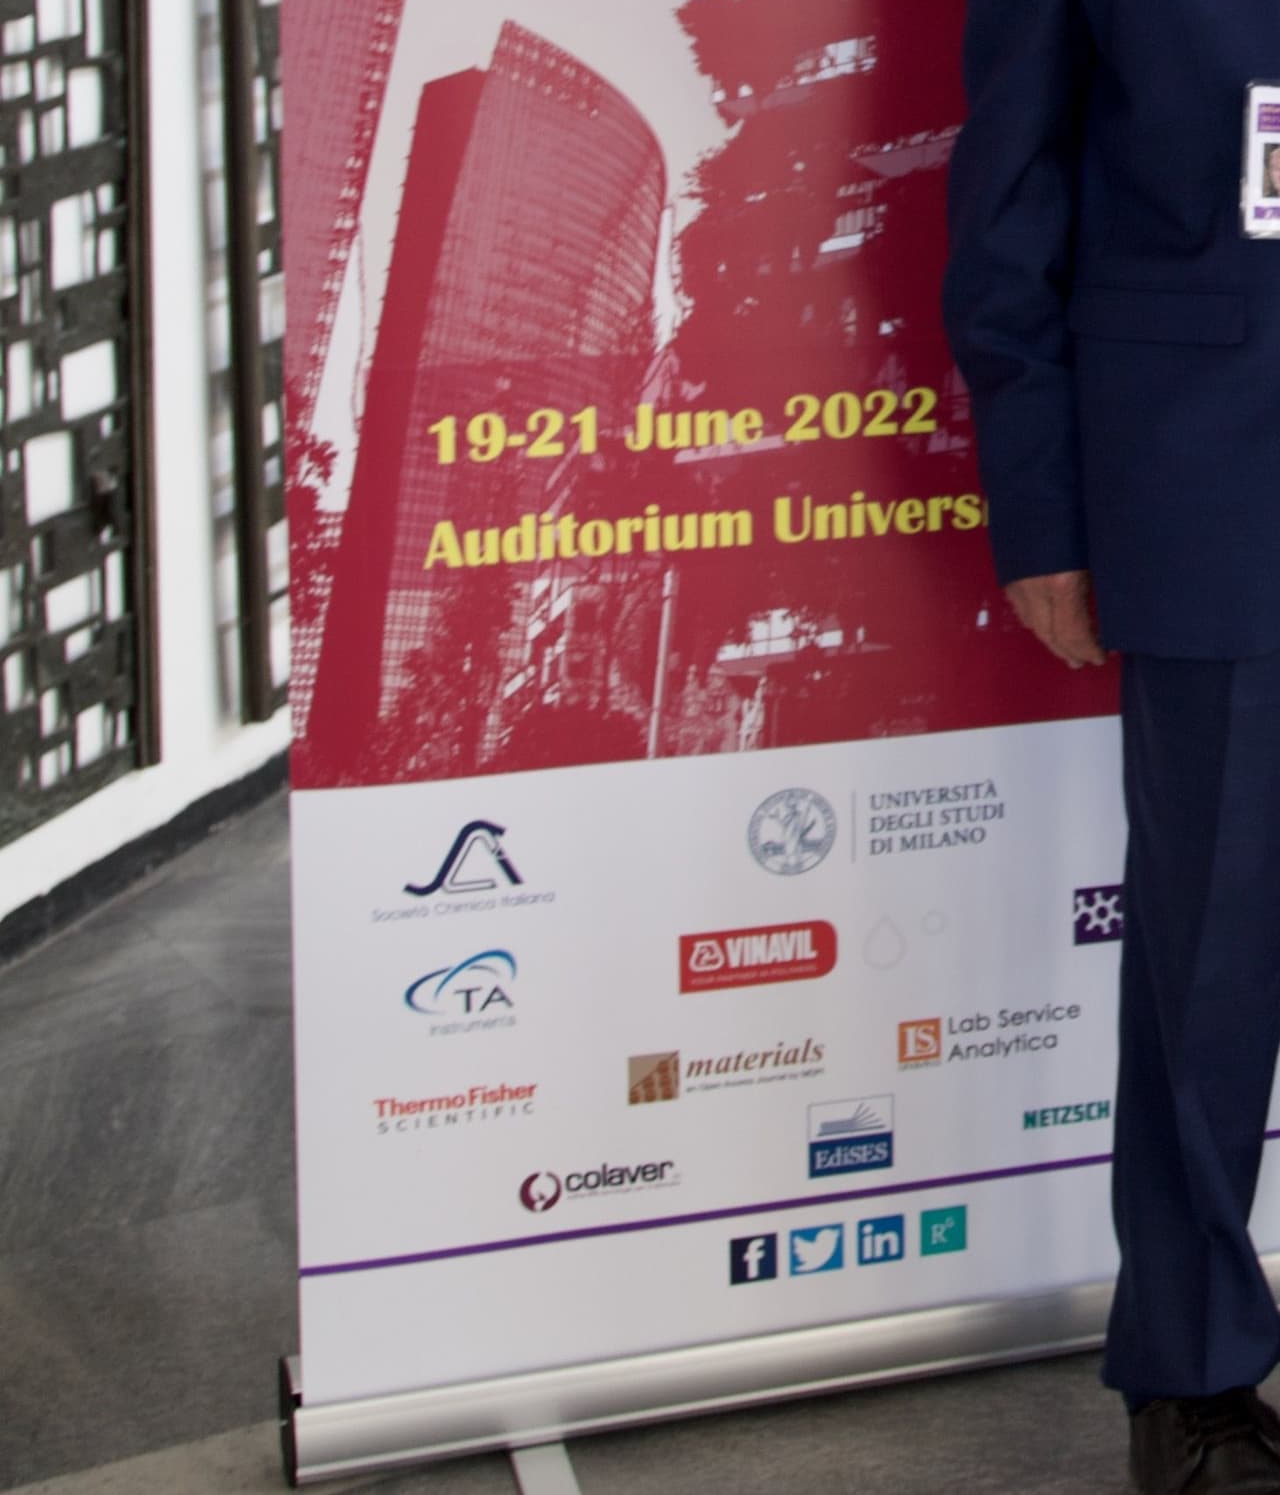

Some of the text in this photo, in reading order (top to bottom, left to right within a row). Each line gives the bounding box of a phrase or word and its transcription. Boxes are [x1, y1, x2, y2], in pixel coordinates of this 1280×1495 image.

[427, 386, 938, 465] 19-21 June 2022
[422, 503, 754, 570] Auditorium
[869, 779, 999, 811] UNIVERSITÀ
[869, 802, 1006, 834] DEGLI STUDI
[869, 826, 987, 856] DI MILANO
[725, 928, 818, 969] VINAVIL
[454, 985, 515, 1014] TA
[948, 1012, 991, 1035] Lab
[997, 1003, 1082, 1029] Service
[685, 1037, 825, 1079] materials
[947, 1032, 1059, 1063] Analytica
[377, 1101, 536, 1135] SCIENTIFIC
[1023, 1099, 1110, 1131] NETZSCH
[814, 1141, 889, 1170] EdiSES
[565, 1160, 674, 1192] colaver
